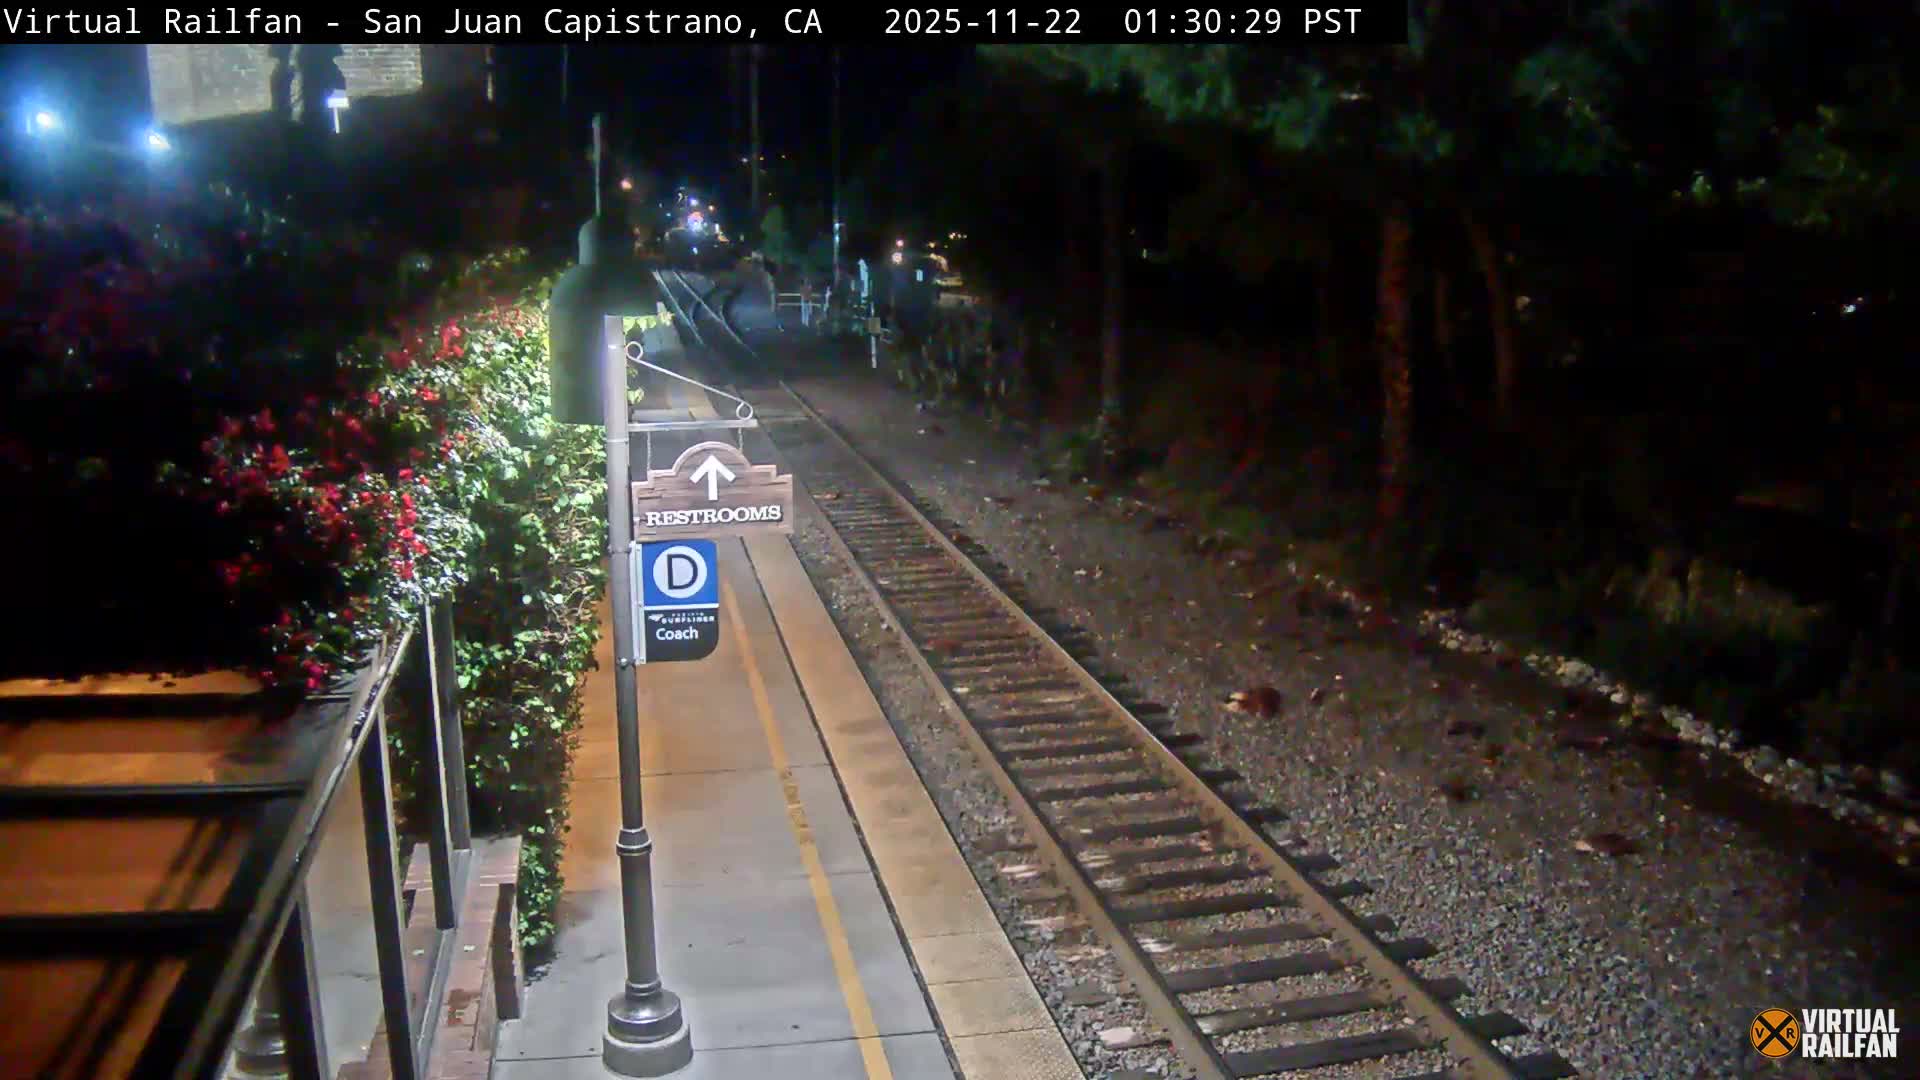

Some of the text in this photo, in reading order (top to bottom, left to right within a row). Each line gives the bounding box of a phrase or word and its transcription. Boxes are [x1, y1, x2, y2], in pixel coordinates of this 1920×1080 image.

[645, 504, 782, 527] RESTROOMS
[666, 553, 699, 590] D
[656, 626, 699, 641] Coach
